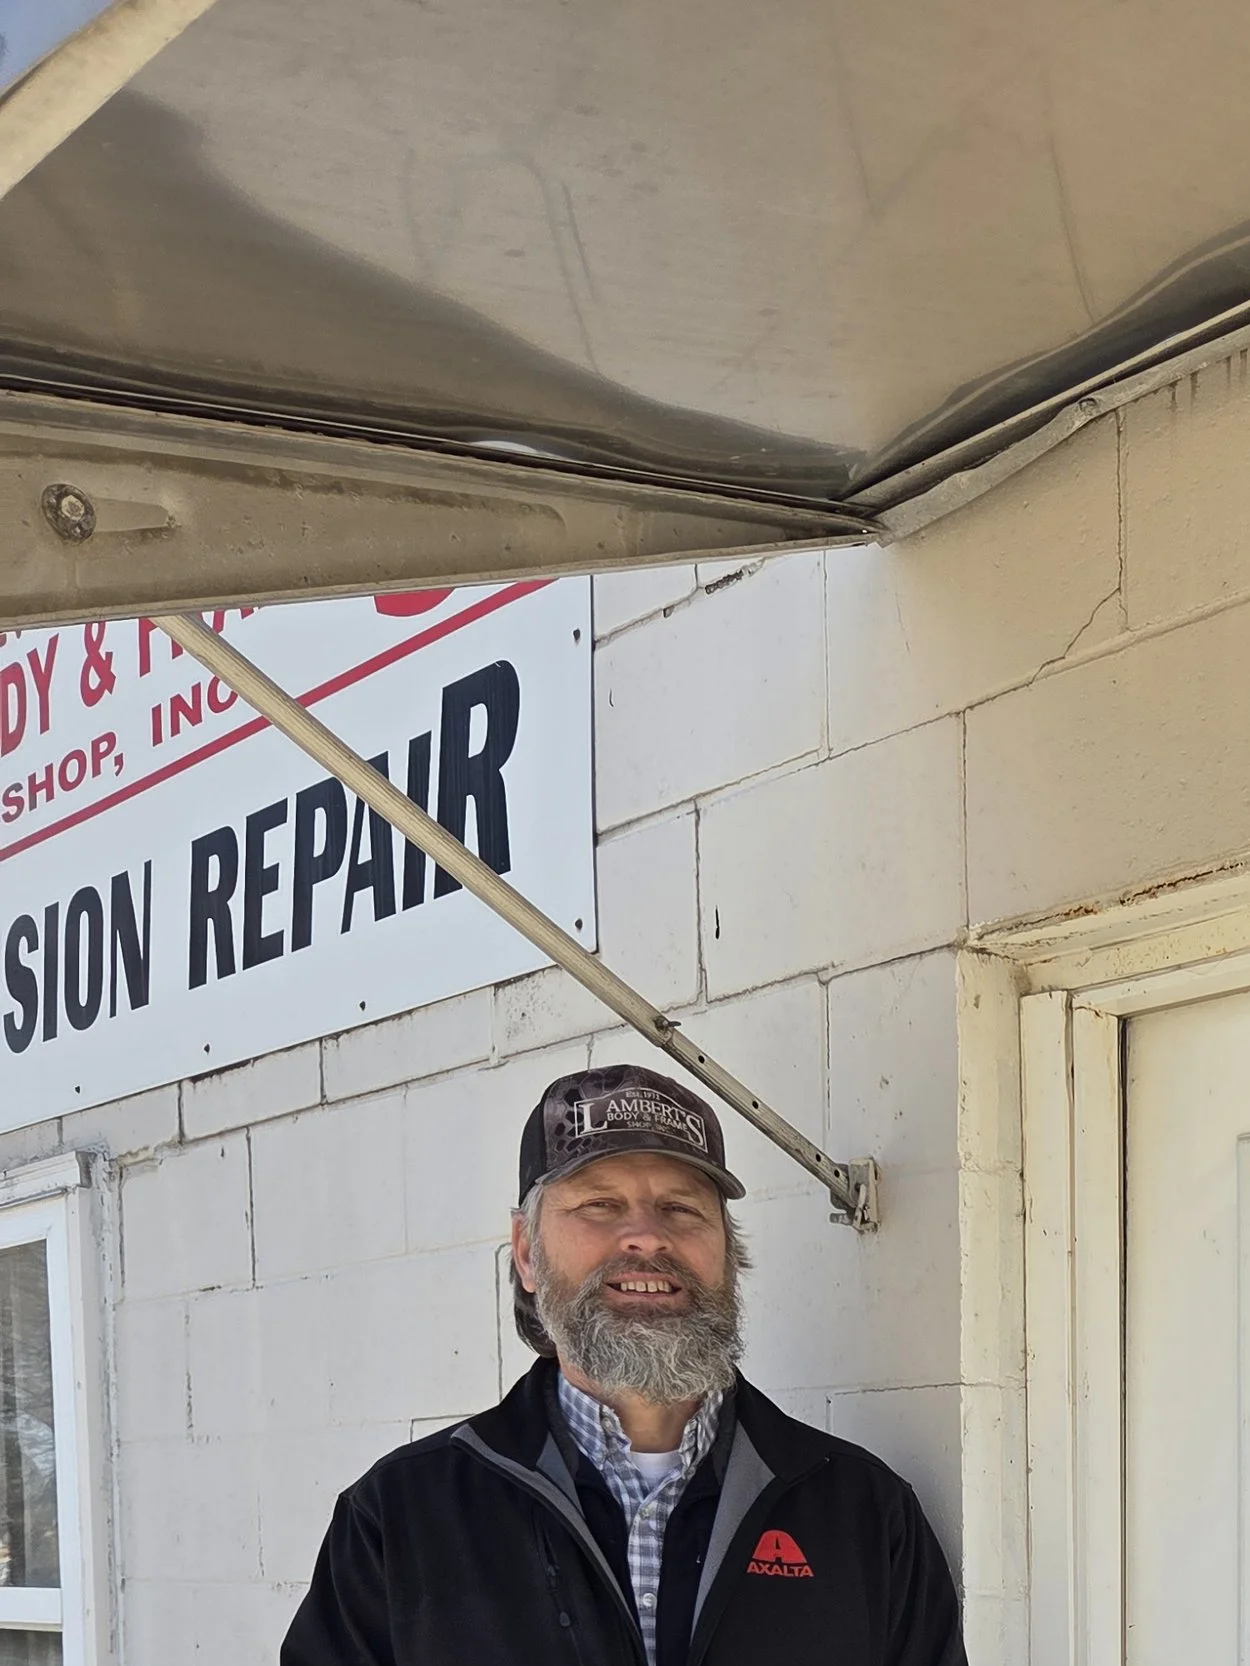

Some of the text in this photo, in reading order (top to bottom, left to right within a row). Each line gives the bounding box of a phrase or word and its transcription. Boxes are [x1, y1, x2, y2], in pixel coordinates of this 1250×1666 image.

[2, 731, 123, 823] SHOP,
[4, 659, 520, 1054] SION REPAIR
[578, 1098, 704, 1147] LAMBERT'S
[607, 1112, 639, 1121] BODY
[642, 1114, 650, 1122] &
[654, 1113, 688, 1131] FRAME
[747, 1561, 814, 1578] AXALTA
